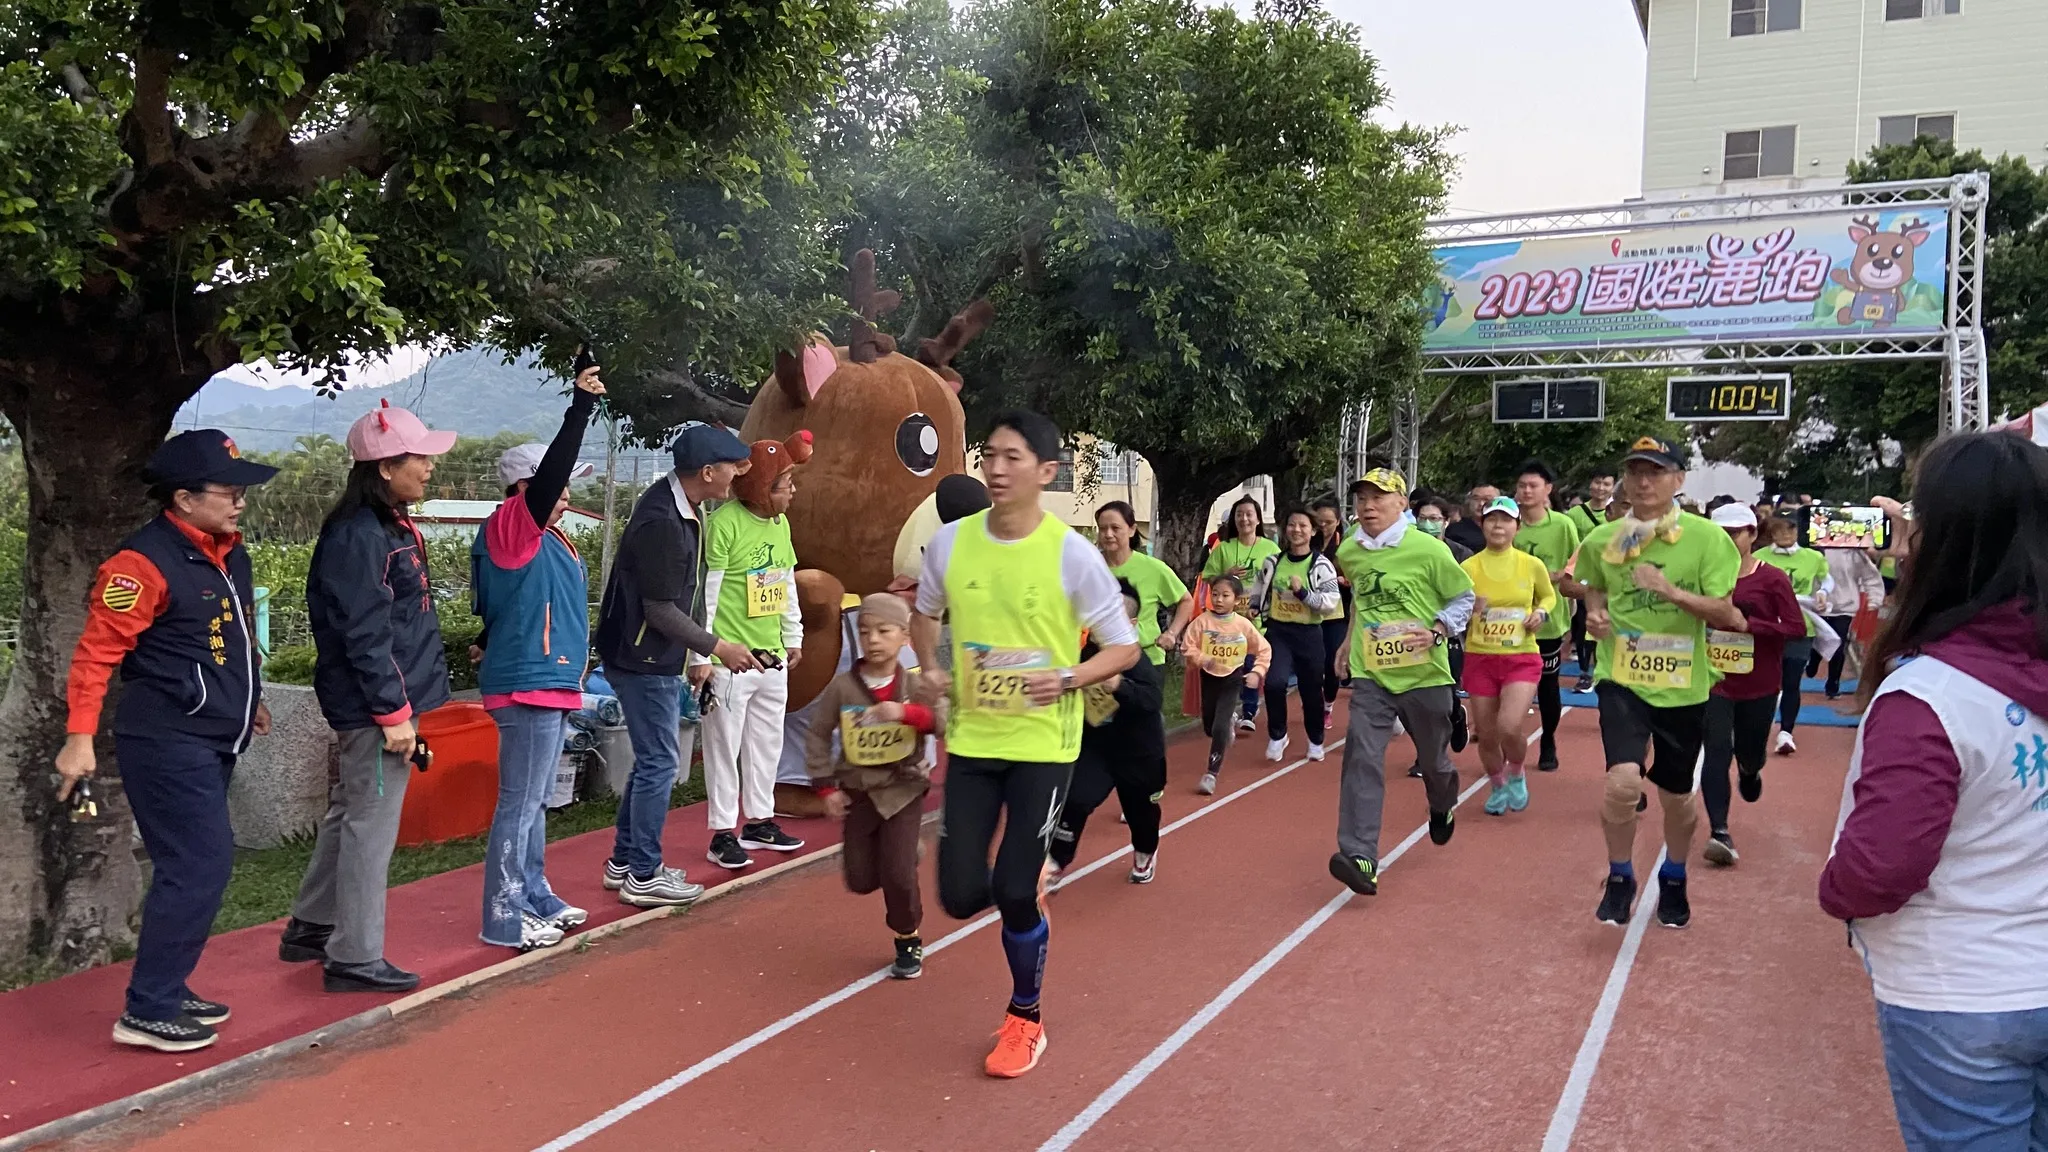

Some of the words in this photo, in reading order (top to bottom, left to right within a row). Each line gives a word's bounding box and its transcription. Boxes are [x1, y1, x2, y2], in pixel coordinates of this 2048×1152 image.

[1474, 268, 1582, 320] 2023
[1483, 623, 1516, 635] 6269
[1211, 645, 1239, 657] 6304
[1706, 647, 1741, 662] 6348
[1630, 655, 1677, 673] 6385
[858, 728, 904, 748] 6024
